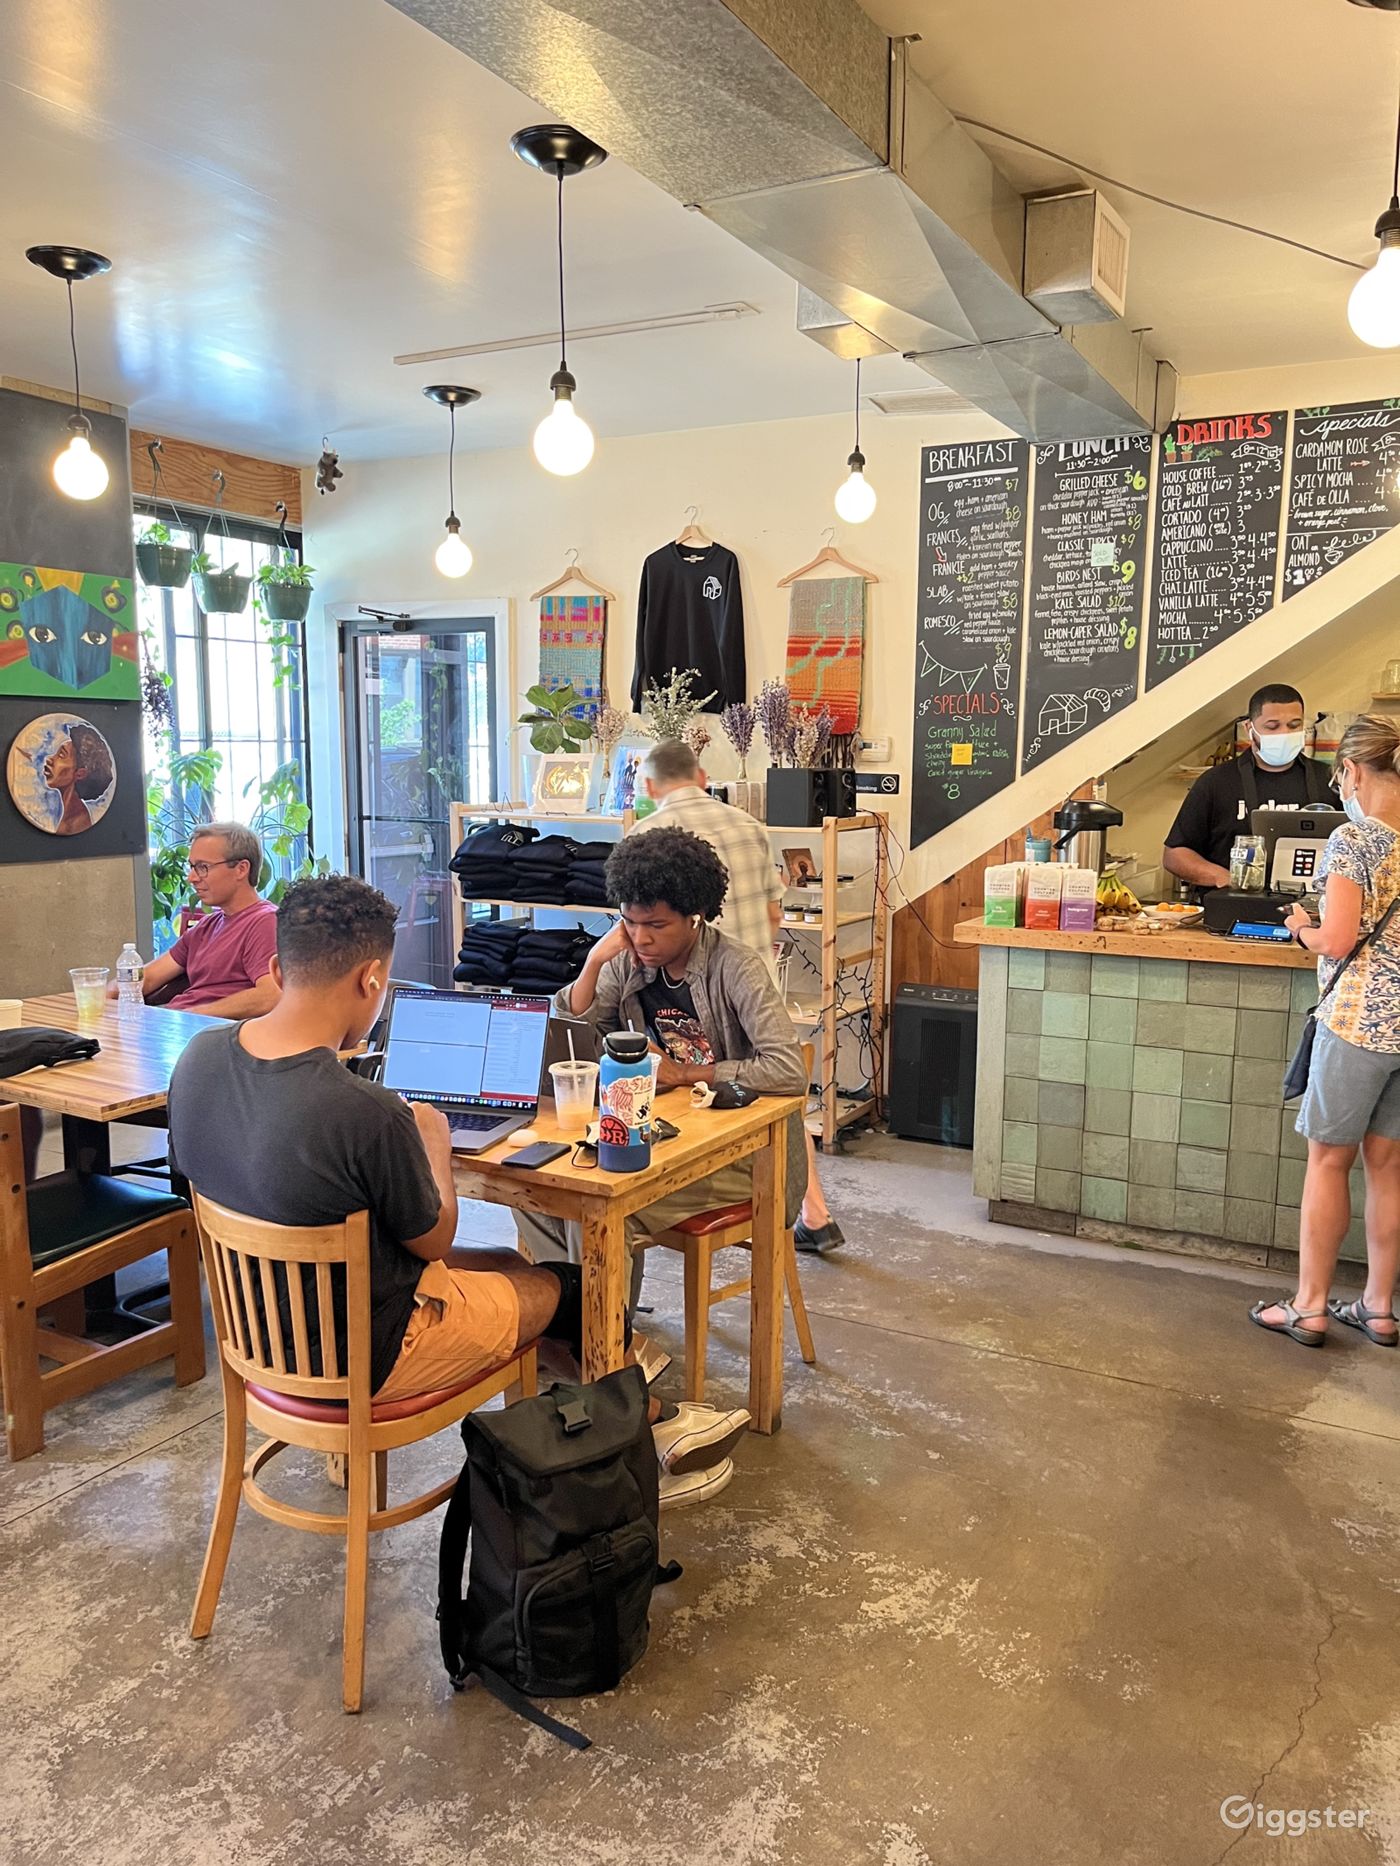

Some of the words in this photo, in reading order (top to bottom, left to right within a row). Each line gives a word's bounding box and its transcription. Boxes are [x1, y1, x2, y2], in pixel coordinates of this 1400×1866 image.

[1176, 413, 1273, 446] DRINKS
[1304, 412, 1393, 440] specials
[1058, 437, 1130, 462] LUNCH
[1346, 437, 1369, 455] ROSE
[929, 440, 1018, 473] BREAKFAST
[1317, 456, 1343, 471] LATTE
[1059, 475, 1090, 492] GRILLED
[1091, 472, 1119, 488] CHEESE
[1162, 470, 1188, 484] HOUSE
[1189, 466, 1217, 481] COFFEE
[1294, 474, 1324, 489] SPICY
[1326, 472, 1354, 488] MOCHA
[1162, 484, 1182, 498] COLD
[1186, 480, 1209, 496] BREW
[1328, 489, 1350, 505] OLLA
[1191, 493, 1210, 508] LAIT
[928, 502, 945, 521] OG
[1061, 511, 1090, 526] HONEY
[1090, 510, 1108, 524] HAM
[1162, 510, 1202, 528] CORTADO
[926, 528, 961, 547] FRANCES
[1160, 523, 1207, 542] AMERICANO
[1057, 538, 1085, 552] CLASSIC
[1160, 538, 1214, 556] CAPPUCCINO
[1291, 534, 1312, 551] OAT
[932, 560, 966, 577] FRANKIE
[1162, 554, 1188, 570] LATTE
[1288, 552, 1320, 568] ALMOND
[1056, 570, 1080, 584] BIRDS
[1082, 567, 1102, 581] NEST
[1160, 568, 1181, 583] ICED
[1183, 567, 1200, 580] TEA
[926, 584, 949, 598] SLAB
[1159, 582, 1181, 596] CHAI
[1183, 579, 1209, 594] LATTE
[1054, 598, 1074, 610] KALE
[1076, 595, 1102, 608] SALAD
[1158, 595, 1192, 611] VANILLA
[1195, 594, 1219, 608] LATTE
[924, 615, 956, 630] ROMESCO
[1158, 611, 1188, 626] MOCHA
[1044, 625, 1092, 640] LEMON-CAPER
[1094, 622, 1119, 638] SALAD
[1158, 627, 1176, 640] HOT
[1176, 626, 1192, 641] TEA
[933, 691, 1000, 715] SPECIALS
[928, 726, 964, 742] Granny
[969, 720, 997, 738] Salad
